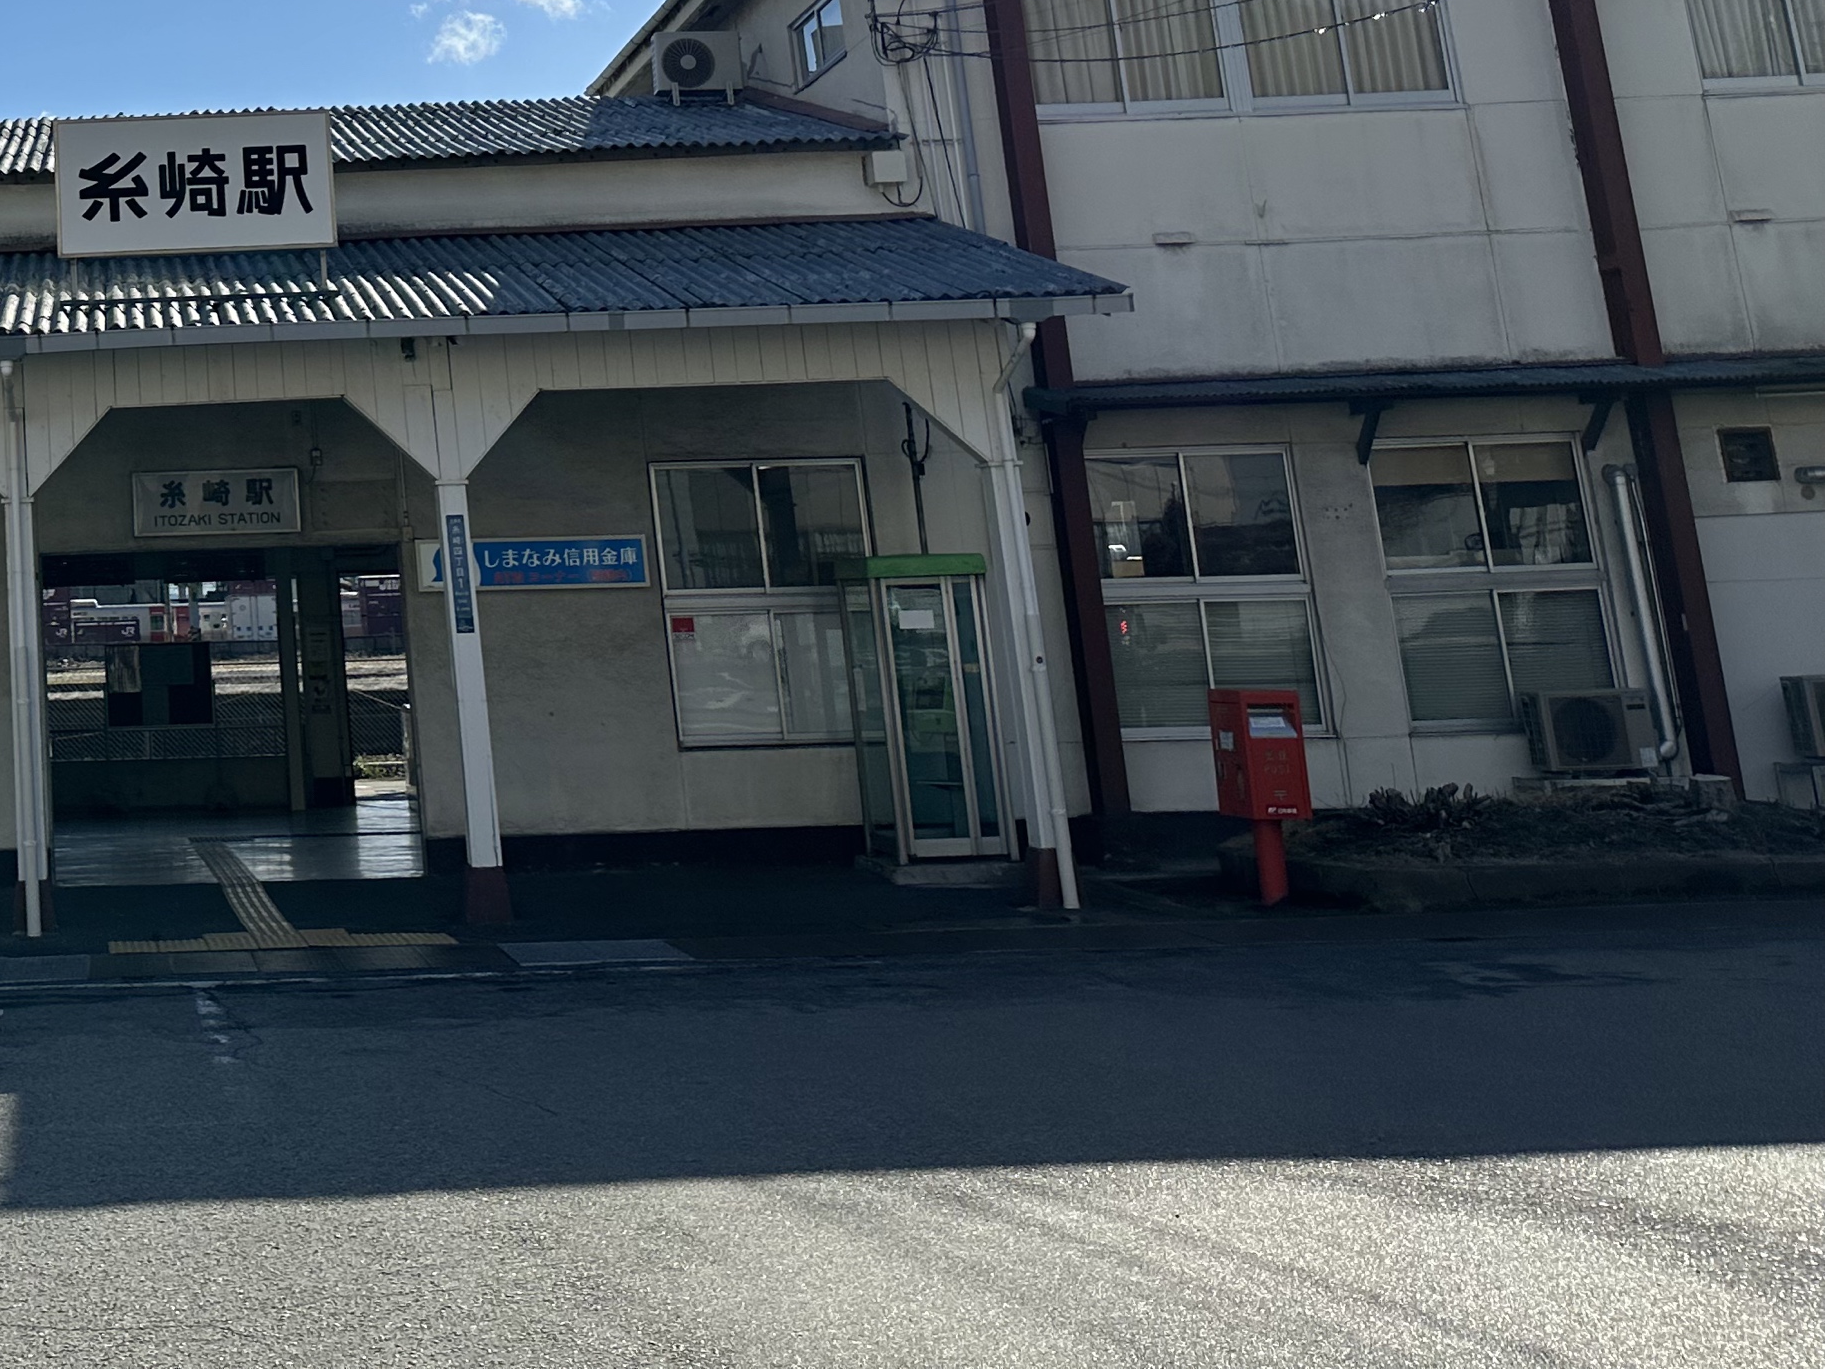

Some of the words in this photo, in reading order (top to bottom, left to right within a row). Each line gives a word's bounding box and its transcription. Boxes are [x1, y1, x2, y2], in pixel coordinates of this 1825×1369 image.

[78, 144, 314, 222] 糸崎駅
[160, 478, 274, 509] 糸崎駅
[154, 513, 212, 527] ITOZAKI
[218, 511, 281, 525] STATION
[484, 547, 638, 569] しまなみ信用金庫
